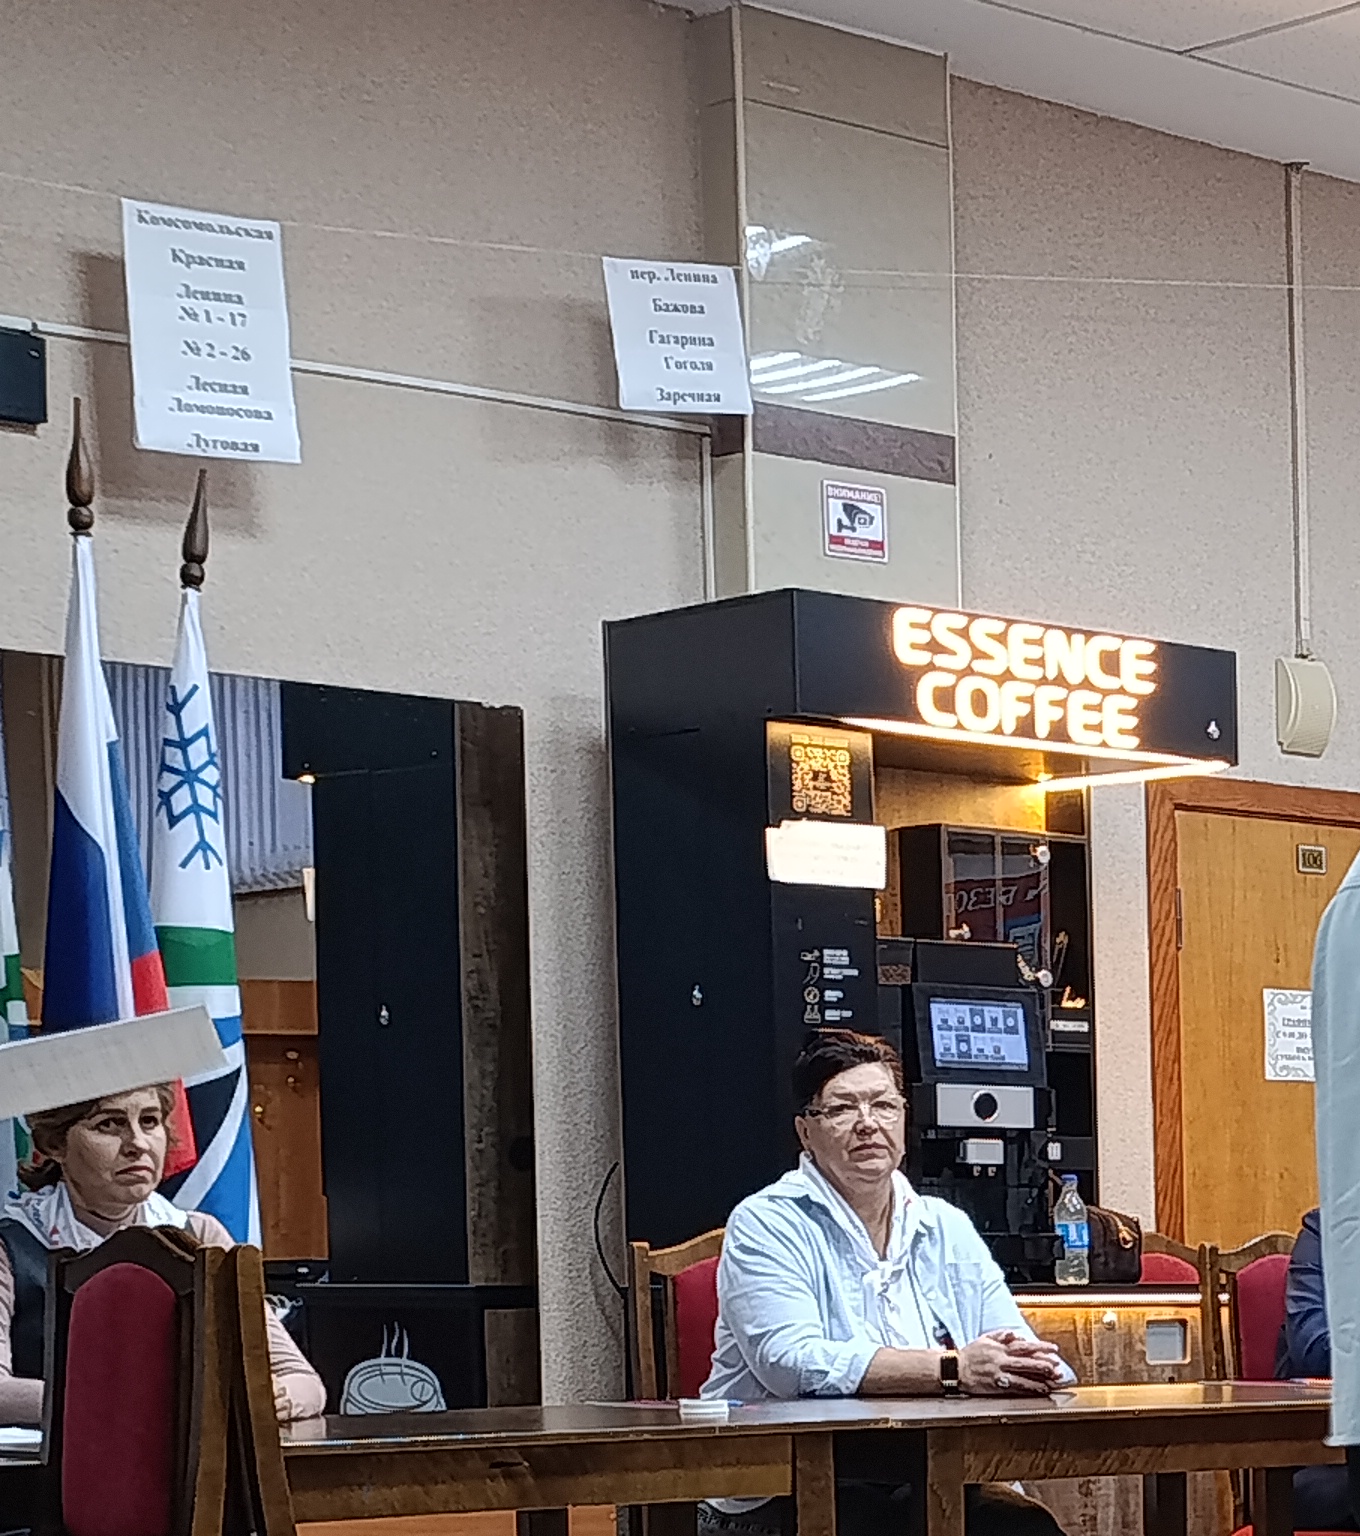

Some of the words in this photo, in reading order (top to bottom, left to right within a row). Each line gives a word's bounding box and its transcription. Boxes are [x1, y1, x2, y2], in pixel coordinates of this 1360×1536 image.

[136, 208, 273, 240] Комсомольская
[170, 248, 245, 270] Красная
[630, 269, 661, 284] пер.
[664, 268, 719, 284] Ленина
[176, 283, 244, 305] Ленина
[178, 306, 200, 323] №
[204, 308, 212, 323] 1
[229, 311, 247, 327] 17
[652, 298, 706, 315] Бажова
[649, 329, 715, 350] Гагарина
[181, 340, 201, 357] №
[205, 342, 216, 358] 2
[231, 345, 251, 361] 26
[664, 356, 713, 371] Гоголя
[187, 375, 249, 395] Лесная
[656, 387, 721, 406] Заречная
[168, 397, 274, 420] Ломоносова
[187, 433, 260, 453] Луговая
[891, 606, 1158, 695] ESSENCE
[916, 670, 1141, 750] COFFEE
